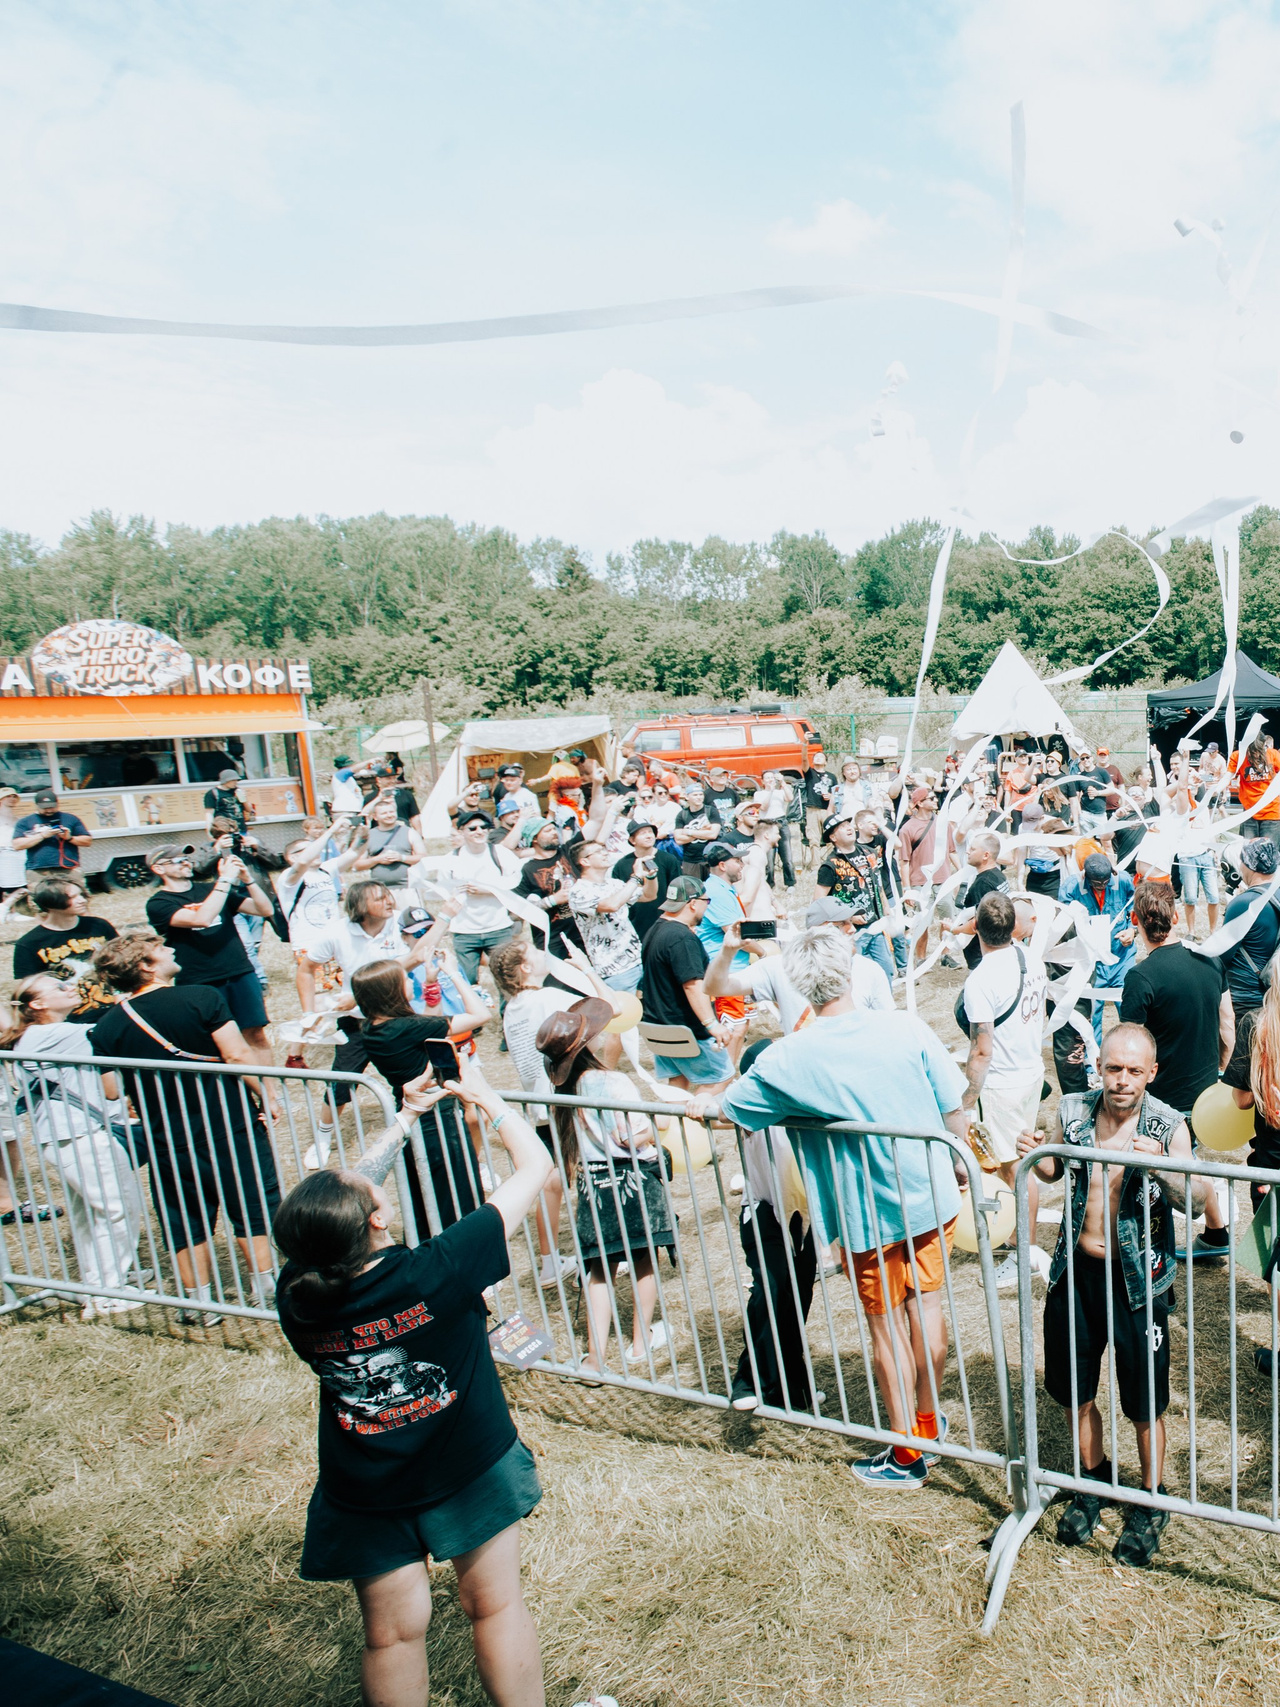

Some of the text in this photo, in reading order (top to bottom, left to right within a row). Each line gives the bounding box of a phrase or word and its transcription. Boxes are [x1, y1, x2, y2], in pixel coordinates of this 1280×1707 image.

[66, 628, 151, 653] SUPER
[80, 647, 147, 666] HERO
[75, 664, 157, 688] TRUCK
[197, 663, 312, 689] КОФЕ
[352, 1335, 380, 1350] НЕ
[382, 1312, 434, 1341] ПАРА
[353, 1317, 390, 1337] ЧТО
[394, 1302, 428, 1324] МЫ
[355, 1418, 407, 1435] WHITE
[411, 1390, 457, 1423] POWR
[373, 1395, 434, 1423] НТИФА
